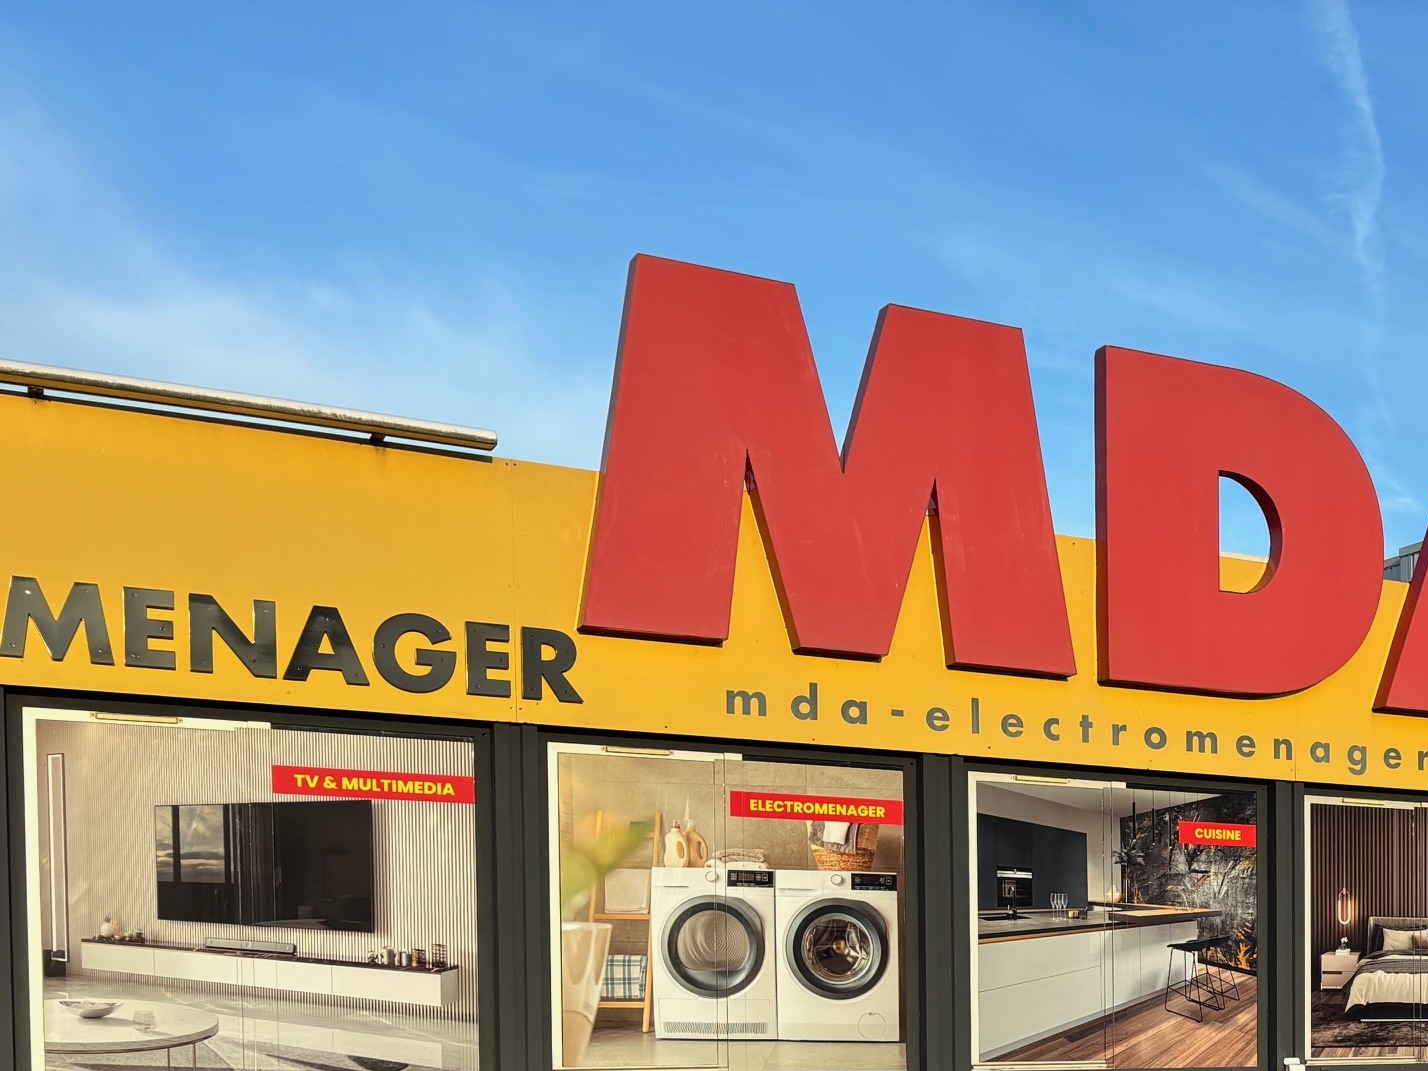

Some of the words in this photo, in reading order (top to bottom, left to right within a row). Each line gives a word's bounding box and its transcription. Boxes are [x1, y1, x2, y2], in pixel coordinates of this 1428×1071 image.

[0, 575, 584, 704] MENAGER
[293, 774, 318, 788] TV
[322, 776, 338, 790] &
[341, 777, 456, 795] MULTIMEDIA
[750, 800, 886, 818] ELECTROMENAGER
[1195, 827, 1241, 841] CUISINE
